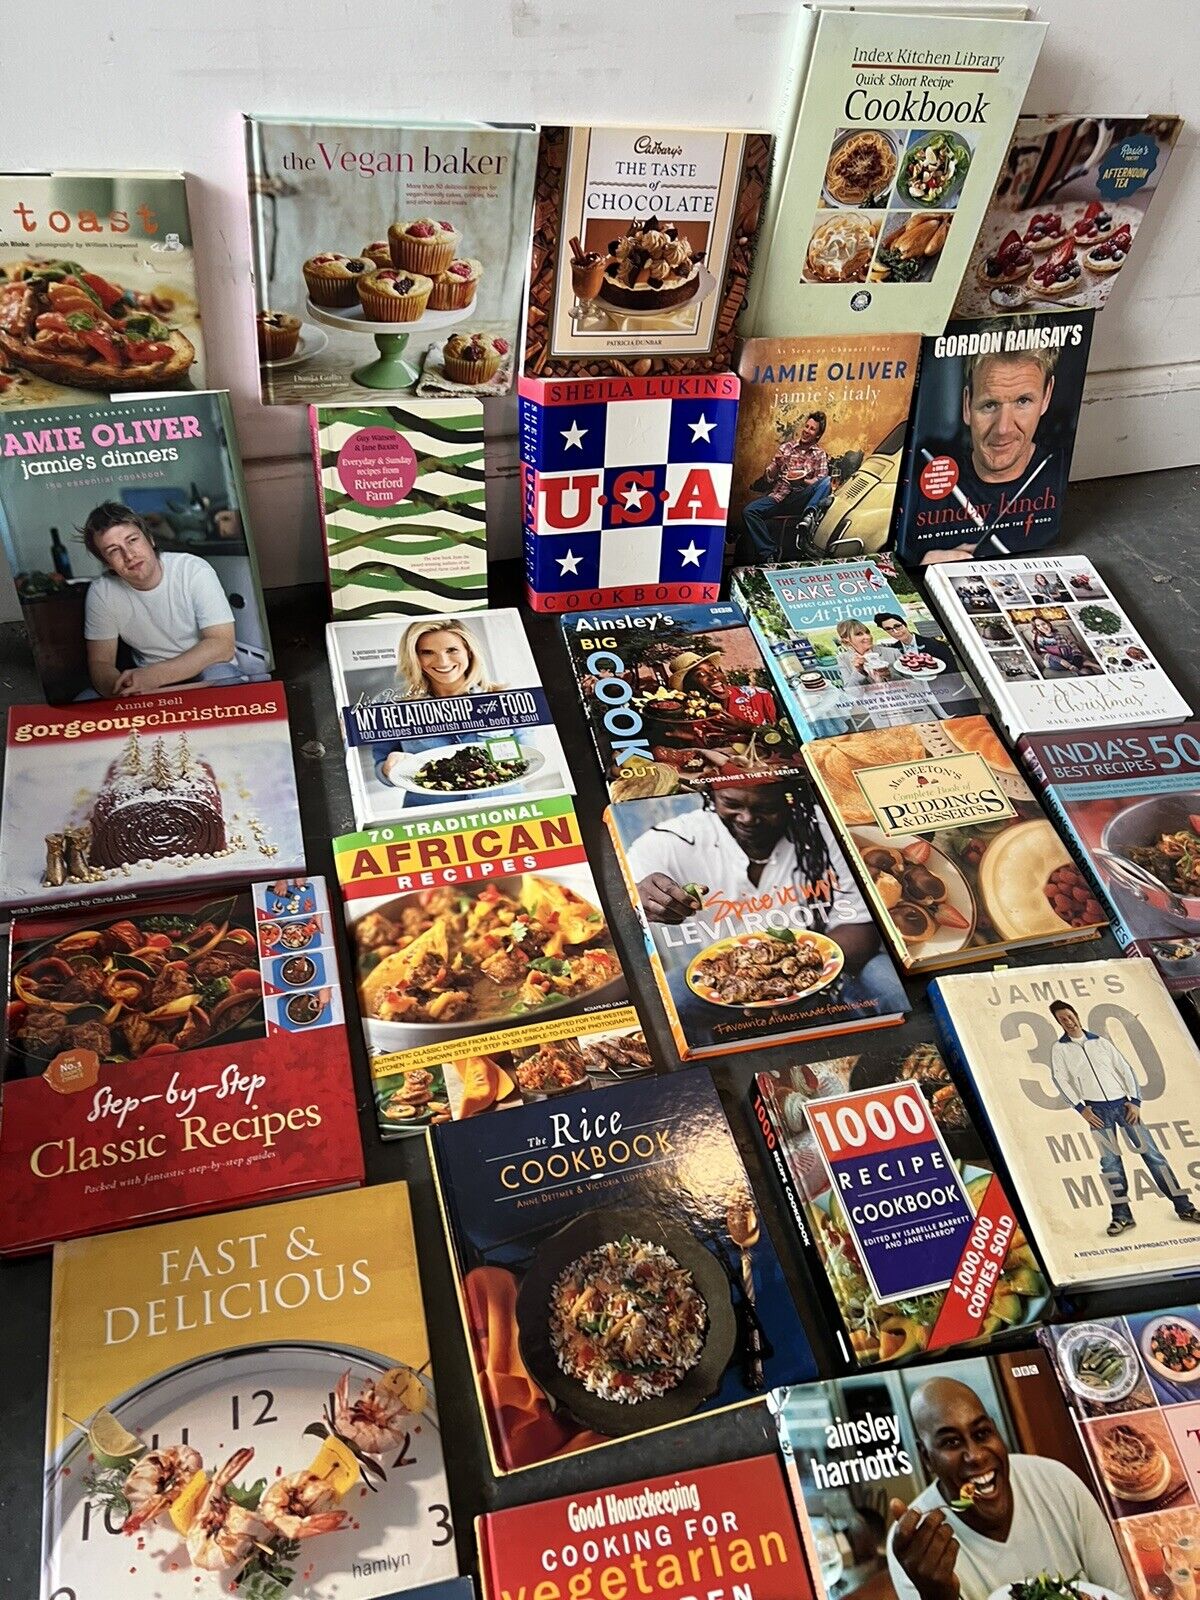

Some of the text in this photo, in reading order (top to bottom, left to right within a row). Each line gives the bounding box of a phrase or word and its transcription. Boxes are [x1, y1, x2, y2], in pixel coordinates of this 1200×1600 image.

[853, 47, 1005, 69] Index Kitchen Library
[855, 73, 954, 90] Quick Short Recipe
[845, 89, 991, 123] Cookbook
[283, 142, 508, 179] the Vegan baker
[633, 135, 683, 159] Cadbury's
[615, 161, 697, 177] THE TASTE
[1102, 167, 1149, 179] AFTERNOON
[1114, 177, 1129, 188] TEA
[649, 180, 660, 192] of
[13, 201, 159, 234] toast
[587, 192, 715, 213] CHOCOLATE
[934, 324, 1083, 359] GORDON RAMSAY'S
[751, 363, 819, 385] JAMIE
[827, 361, 908, 381] OLIVER
[551, 378, 733, 402] SHEILA LUKINS
[770, 384, 881, 409] jamie's italy
[0, 415, 203, 457] AMIE OLIVER
[356, 433, 396, 444] Guy Watson
[20, 447, 179, 480] jamie's dinners
[342, 455, 413, 469] Everyday & Sunday
[356, 466, 400, 478] recipes from
[354, 477, 403, 490] Riverford
[366, 489, 394, 502] Farm
[997, 487, 1056, 517] lunch
[935, 529, 959, 538] OTHER
[961, 525, 989, 534] RECIPES
[990, 522, 1010, 530] FROM
[1034, 517, 1052, 525] WORD
[776, 578, 797, 587] THE
[800, 574, 834, 584] GREAT
[968, 559, 1064, 574] TANYA BURR
[544, 585, 717, 610] COOKBOOK
[781, 584, 837, 602] BAKE
[576, 613, 675, 633] Ainsley's
[710, 606, 733, 615] BBC
[801, 604, 888, 624] At Home
[580, 637, 618, 650] BIG
[1030, 674, 1145, 699] TANYA'S
[1053, 690, 1144, 714] Christmas
[114, 697, 184, 711] Annie Bell
[356, 704, 383, 731] MY
[382, 698, 473, 730] RELATIONSHIP
[501, 692, 537, 716] FOOD
[586, 651, 656, 768] COOK
[359, 712, 540, 741] 100 recipes to nourish mind, body & soul
[1042, 737, 1148, 766] INDIA'S
[620, 766, 658, 780] OUT
[1053, 760, 1157, 779] BEST RECIPES
[368, 803, 544, 843] 70 TRADITIONAL
[879, 788, 1005, 830] PUDDINGS
[903, 805, 987, 828] & DESSERTS
[351, 816, 573, 879] AFRICAN
[397, 855, 538, 890] RECIPES
[704, 889, 774, 923] Spice
[774, 885, 798, 906] it
[661, 898, 858, 949] LEVI ROOTS
[987, 973, 1126, 1007] JAMIE'S
[584, 1000, 629, 1013] ROSAMUND GRANT
[373, 1009, 633, 1065] AUTHENTIC CLASSIC DISHES FROM ALL OVER AFRICA ADAPTED FOR THE WESTERN
[86, 1063, 267, 1129] Step-by-Step
[527, 1106, 623, 1149] The Rice
[754, 1094, 776, 1150] 1000
[814, 1094, 927, 1152] 1000
[30, 1103, 323, 1179] Classic Recipes
[1045, 1119, 1200, 1165] MINUTE
[84, 1151, 277, 1195] Packed with fantastic step-by-step guides
[500, 1129, 677, 1189] COOKBOOK
[838, 1151, 945, 1191] RECIPE
[772, 1150, 811, 1248] RECIPE COOKBOOK
[1061, 1160, 1200, 1210] MEALS
[852, 1184, 960, 1225] COOKBOOK
[863, 1215, 971, 1247] EDITED BY ISABELLE BARRETT
[884, 1227, 957, 1250] AND JANE HARROP
[160, 1226, 322, 1287] FAST &
[953, 1215, 994, 1301] 1,000,000
[967, 1214, 1014, 1320] COPIES SOLD
[103, 1258, 374, 1346] DELICIOUS
[1012, 1363, 1040, 1378] BBC
[231, 1388, 278, 1430] 12
[824, 1411, 902, 1450] ainsley
[810, 1445, 914, 1490] harriott's
[567, 1480, 702, 1534] Good Housekeeping
[428, 1503, 454, 1547] 3
[541, 1510, 739, 1572] COOKING FOR
[351, 1550, 412, 1579] hamlyn
